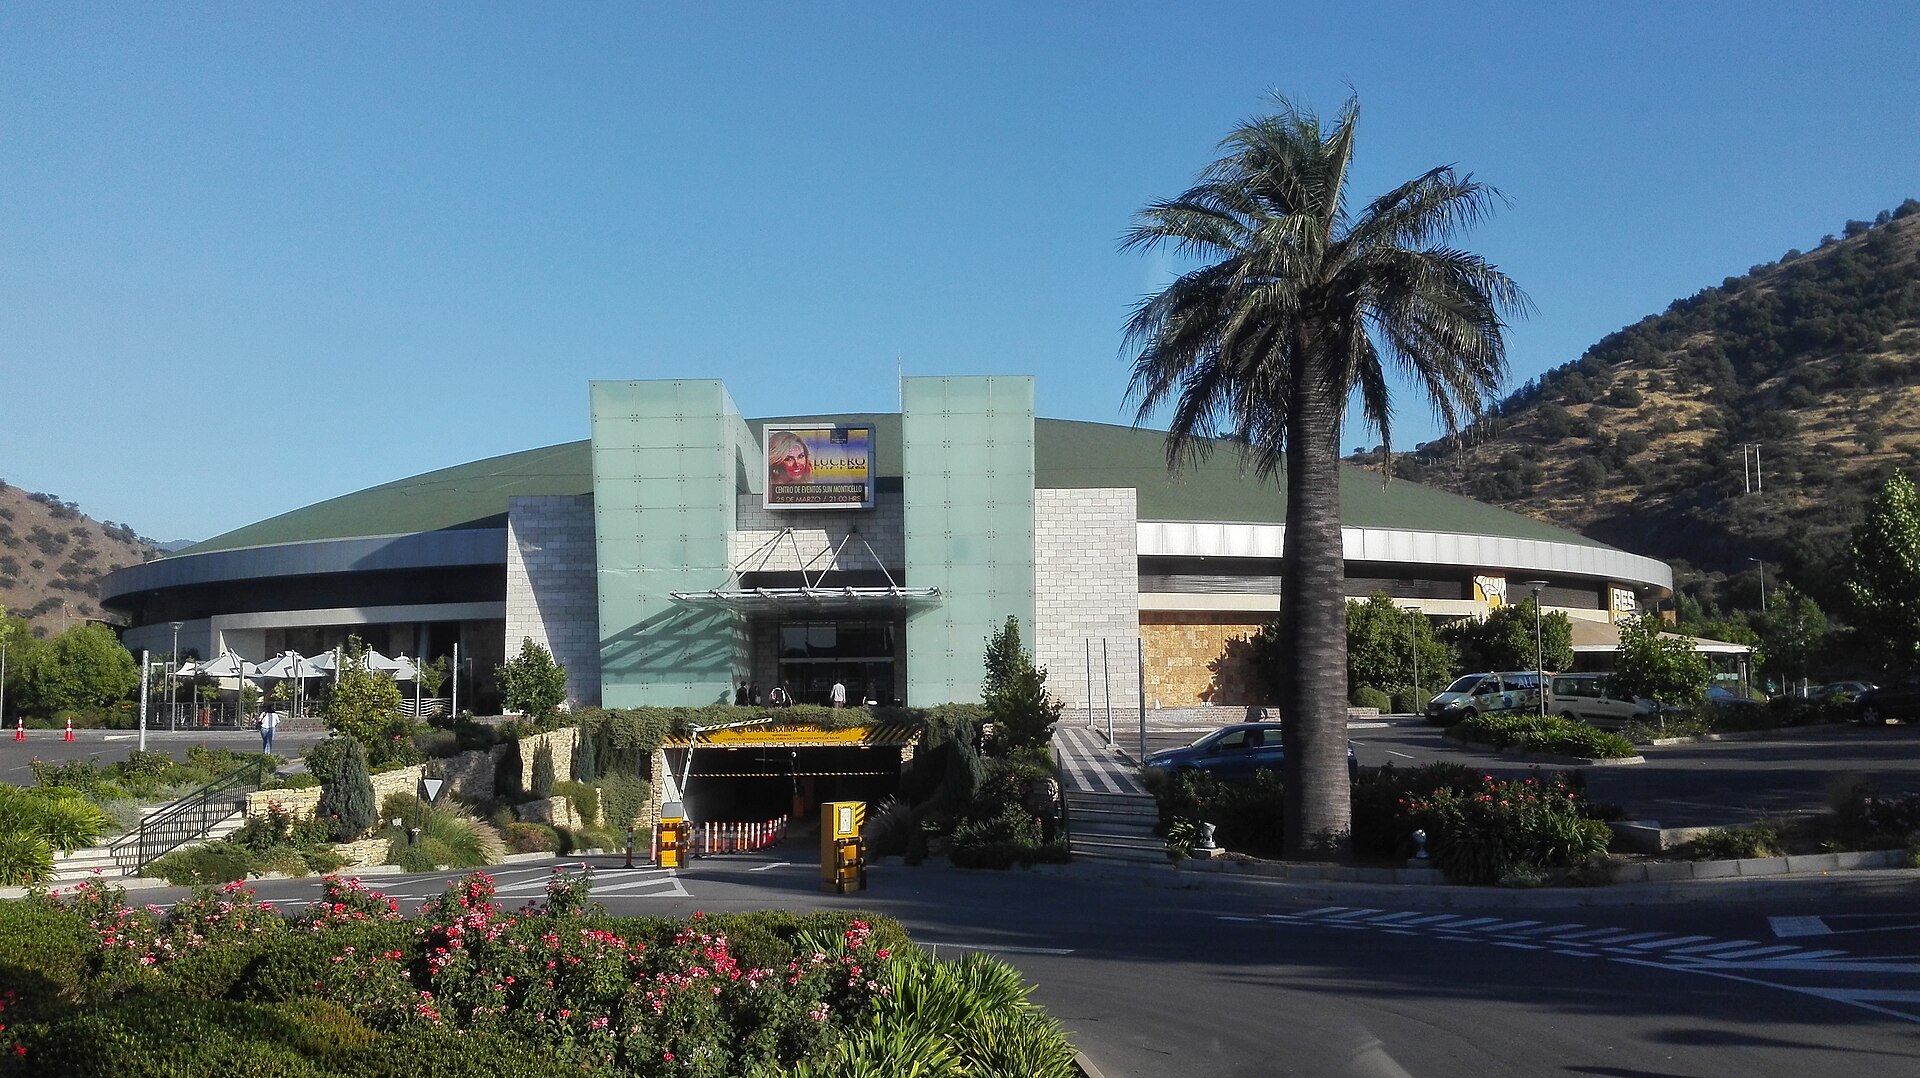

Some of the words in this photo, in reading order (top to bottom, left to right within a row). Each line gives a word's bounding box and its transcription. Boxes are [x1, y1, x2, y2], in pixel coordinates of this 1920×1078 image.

[813, 457, 865, 466] LUCERO
[775, 485, 794, 494] CENTRO
[794, 485, 801, 494] DE
[801, 485, 822, 494] EVENTOS
[822, 485, 832, 493] SUN
[833, 484, 863, 493] MONTICELLO
[829, 495, 848, 503] 21:00
[848, 495, 861, 503] HRS
[1517, 676, 1534, 688] ALL
